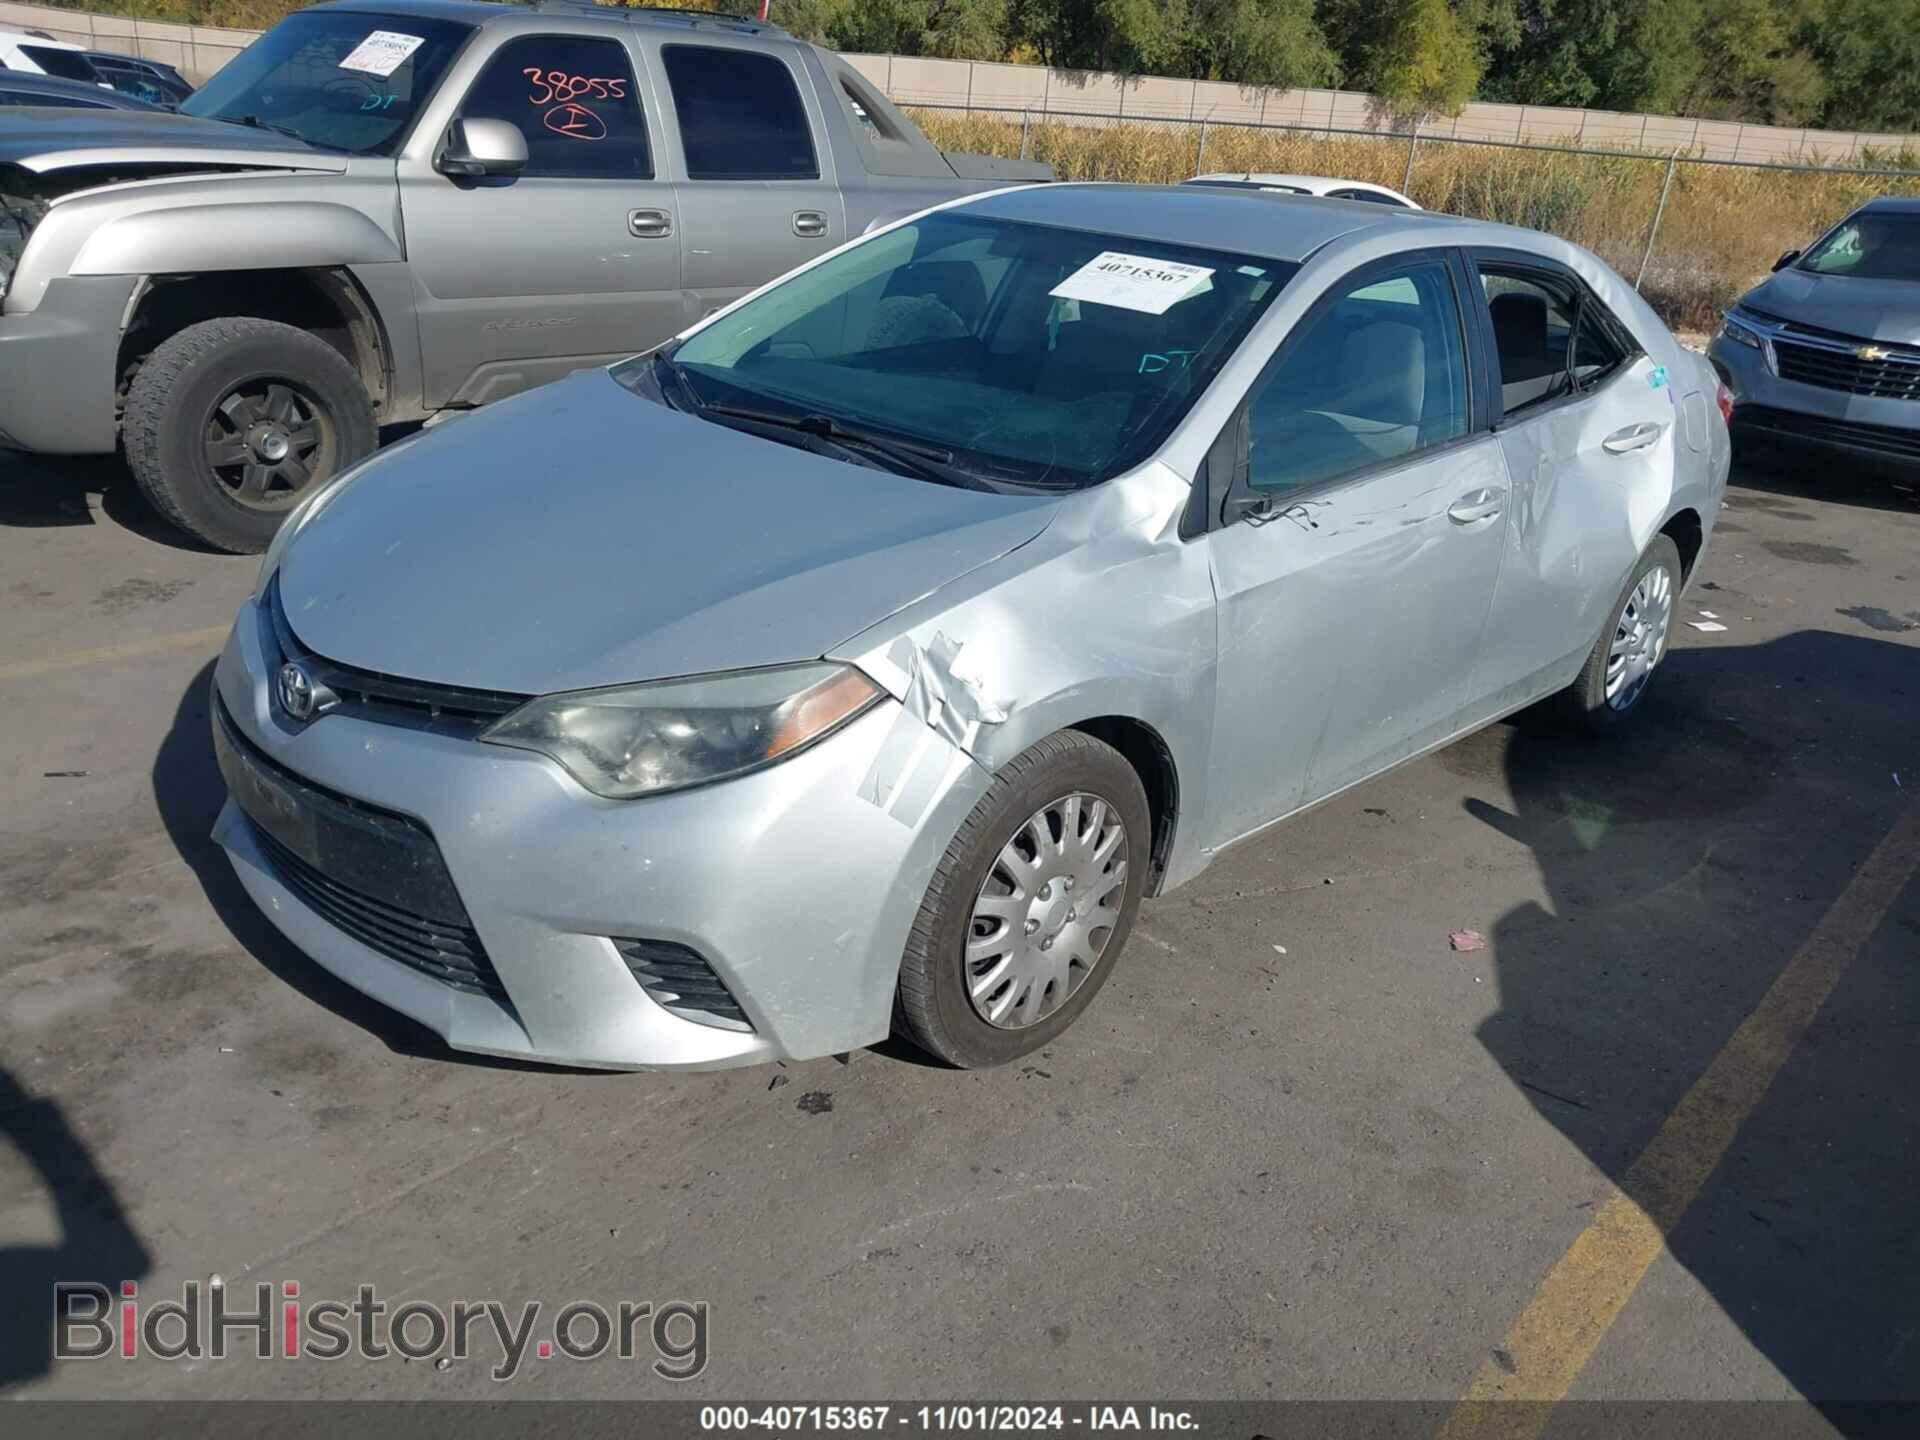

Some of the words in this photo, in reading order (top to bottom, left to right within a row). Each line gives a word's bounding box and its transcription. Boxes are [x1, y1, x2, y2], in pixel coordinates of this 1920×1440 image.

[523, 67, 627, 104] 38055
[361, 94, 399, 110] DT
[1096, 260, 1189, 284] 40715367
[1138, 349, 1200, 374] DT
